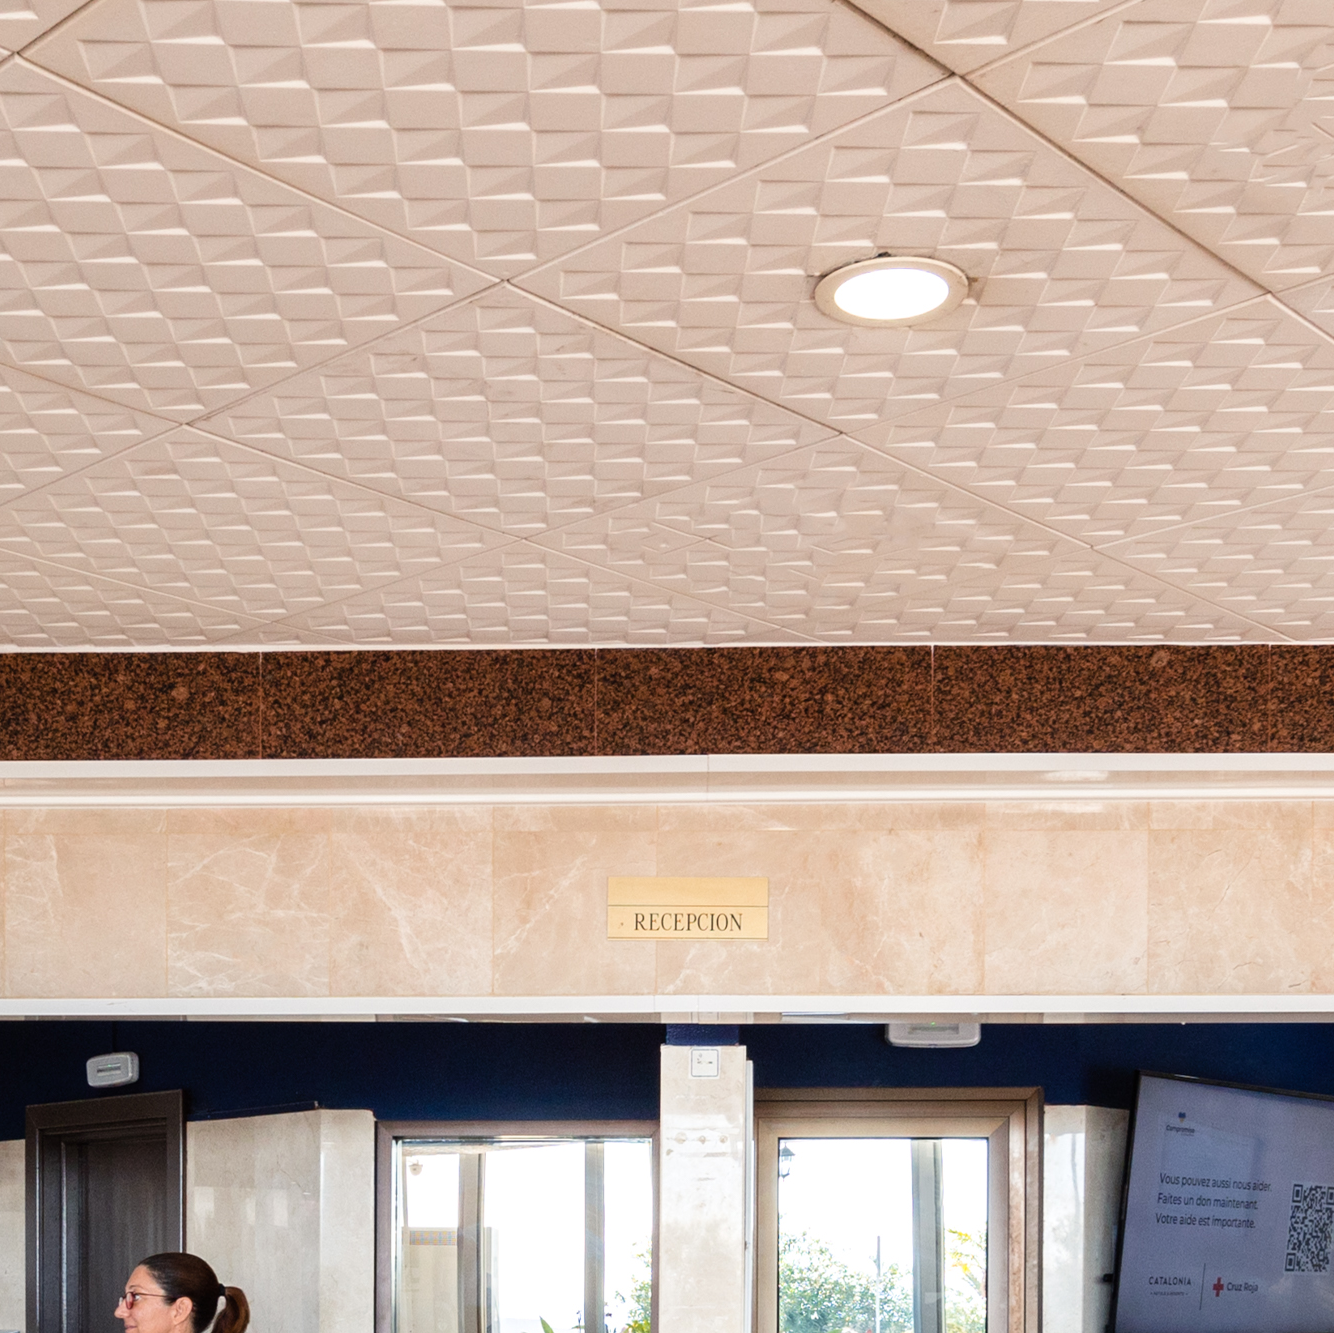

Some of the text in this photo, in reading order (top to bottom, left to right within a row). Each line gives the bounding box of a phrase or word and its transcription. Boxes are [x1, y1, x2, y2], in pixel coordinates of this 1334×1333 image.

[634, 913, 743, 931] RECEPCION
[1160, 1172, 1180, 1185] Vous
[1181, 1176, 1211, 1188] pouvez
[1211, 1178, 1231, 1188] aussi
[1233, 1181, 1251, 1190] nous
[1157, 1192, 1258, 1210] Faites un don maintenant.
[1155, 1213, 1255, 1229] Votre aide est importante.
[1148, 1276, 1191, 1286] CATALONIA
[1227, 1282, 1258, 1293] Cruz Roja
